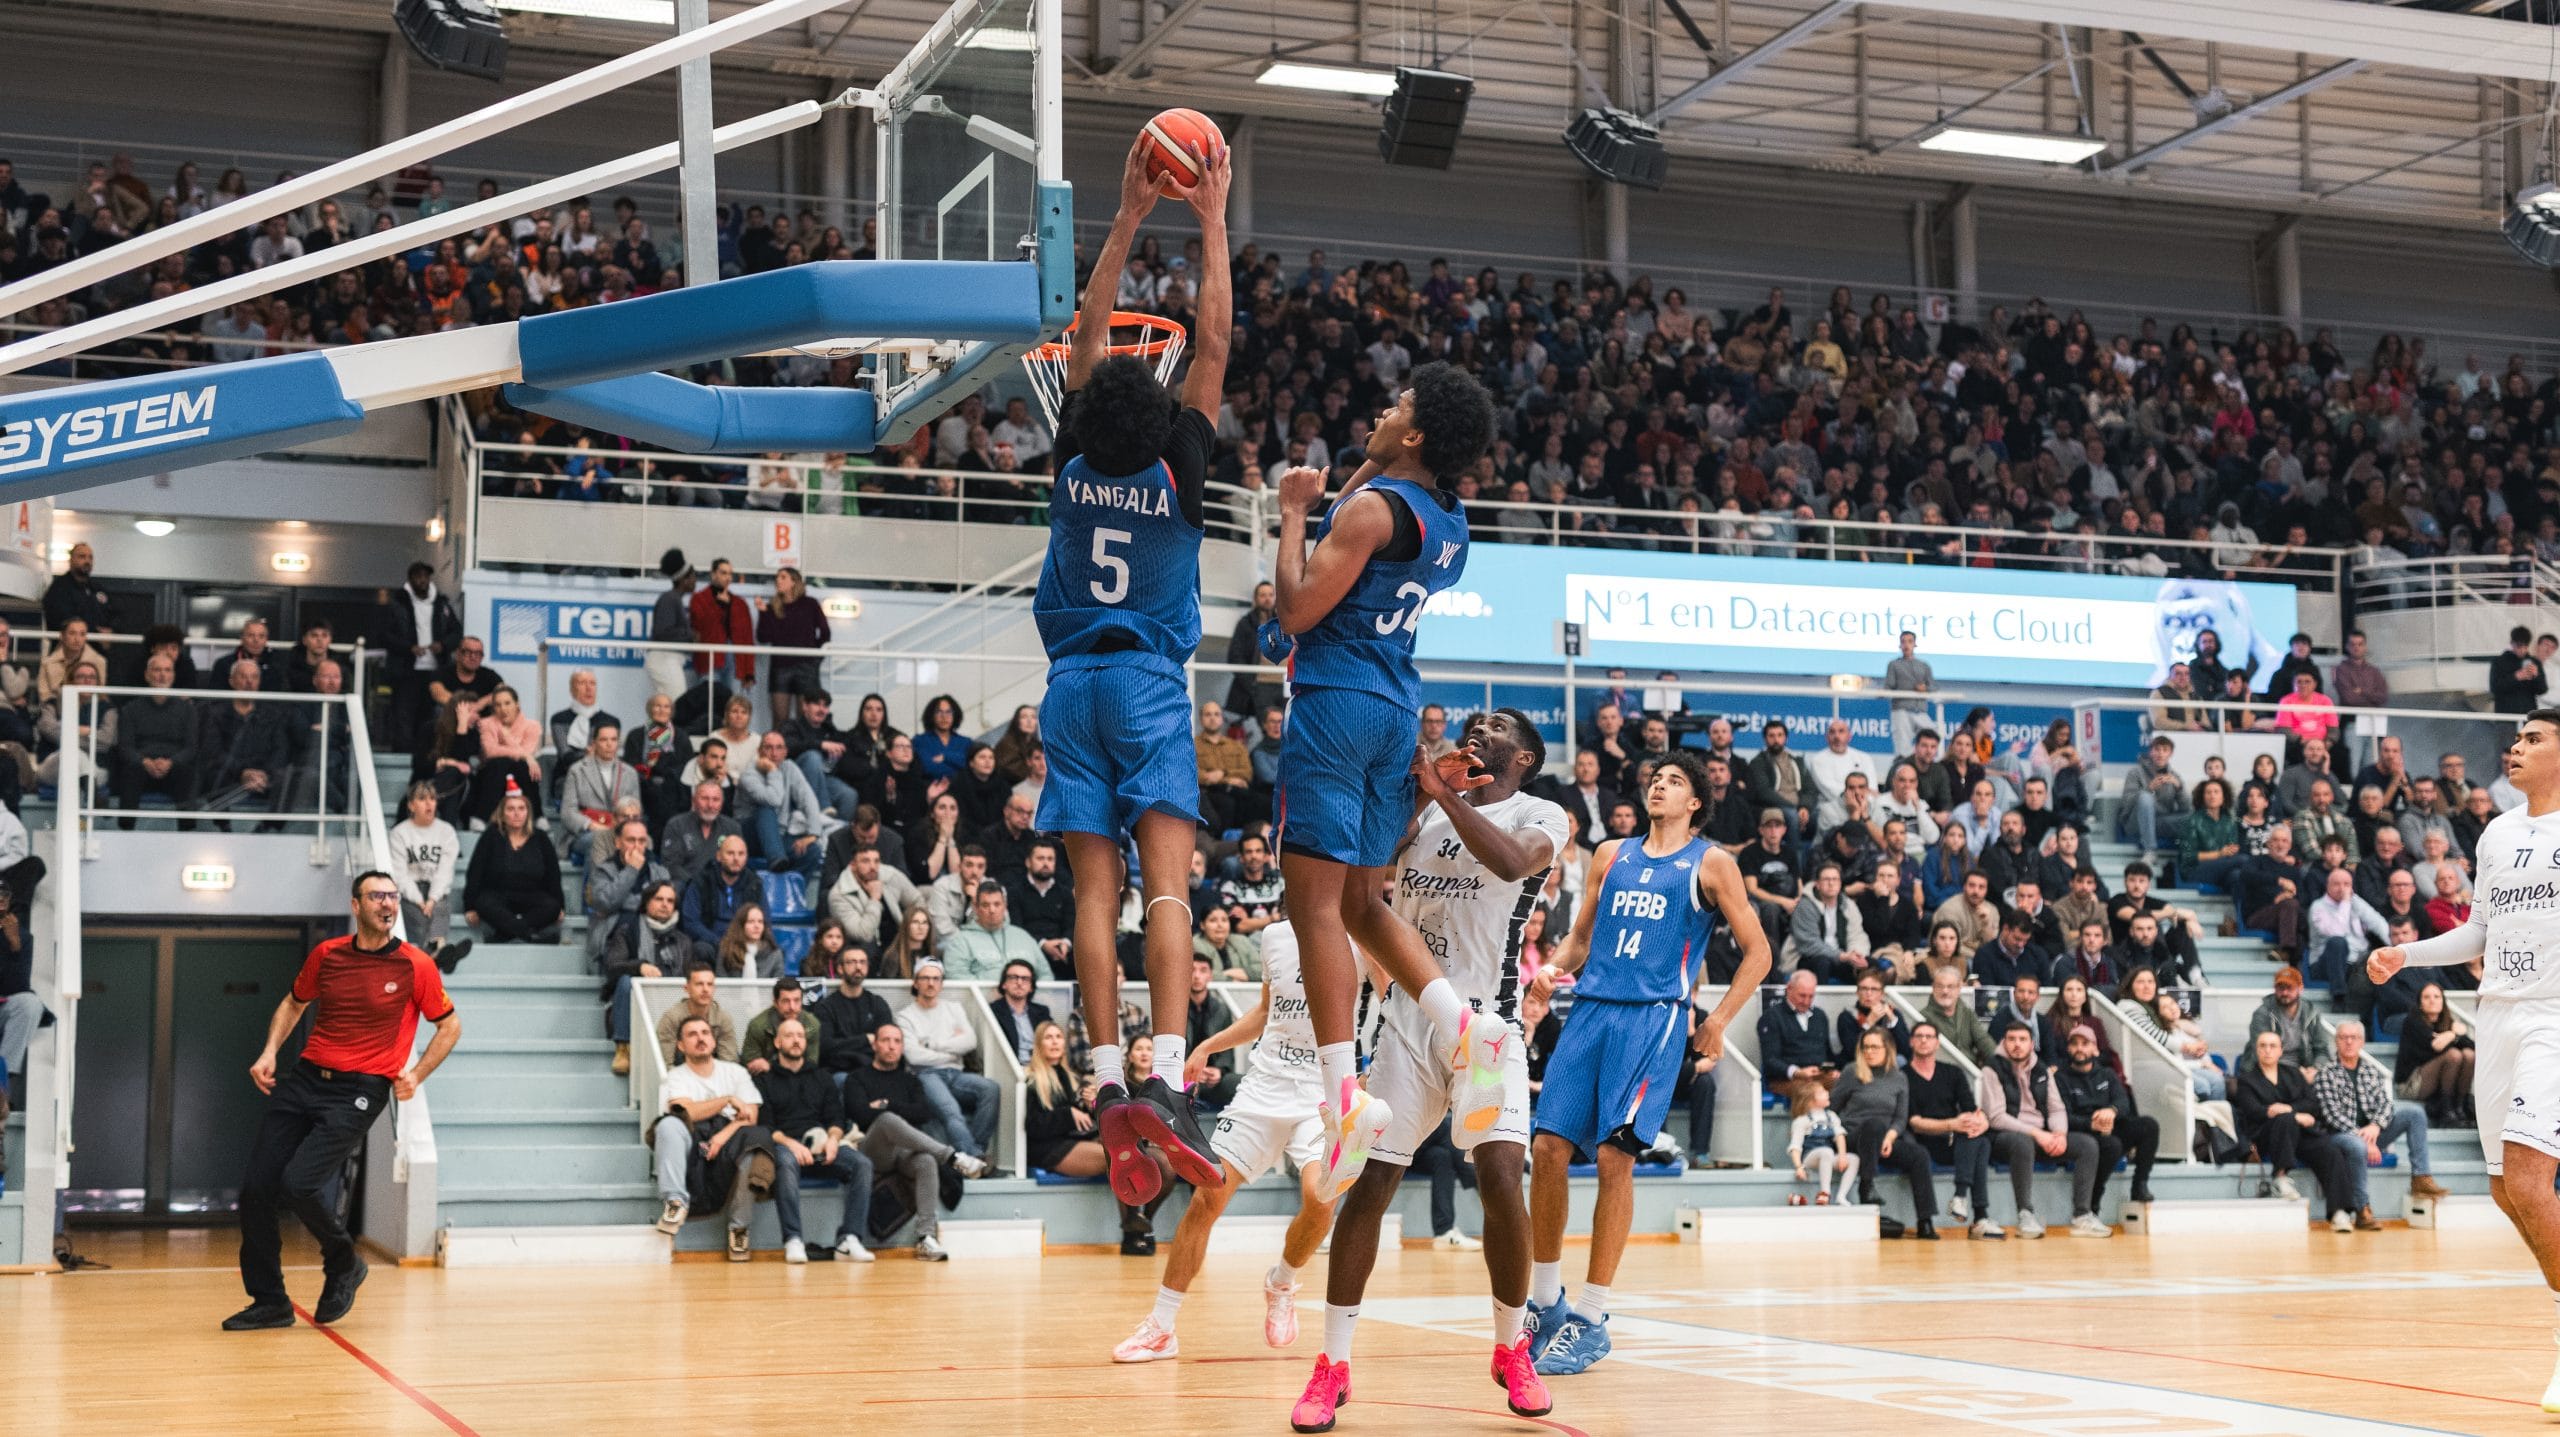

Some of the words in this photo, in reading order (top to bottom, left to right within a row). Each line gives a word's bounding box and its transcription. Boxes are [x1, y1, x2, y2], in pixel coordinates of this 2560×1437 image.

[0, 385, 217, 466] SYSTEM
[1067, 476, 1170, 517] YANGALA
[774, 523, 790, 551] B
[1089, 526, 1132, 605] 5
[1421, 590, 1493, 617] lue.
[1670, 603, 1714, 629] en
[1729, 596, 1934, 637] Datacenter
[1946, 610, 1980, 639] et
[1992, 608, 2093, 645] Cloud
[2084, 711, 2094, 739] B
[1437, 838, 1462, 861] 34
[2513, 848, 2534, 868] 77
[1611, 890, 1668, 920] PFBB
[1614, 928, 1643, 959] 14
[2498, 945, 2537, 978] itga
[1278, 1040, 1317, 1066] itga
